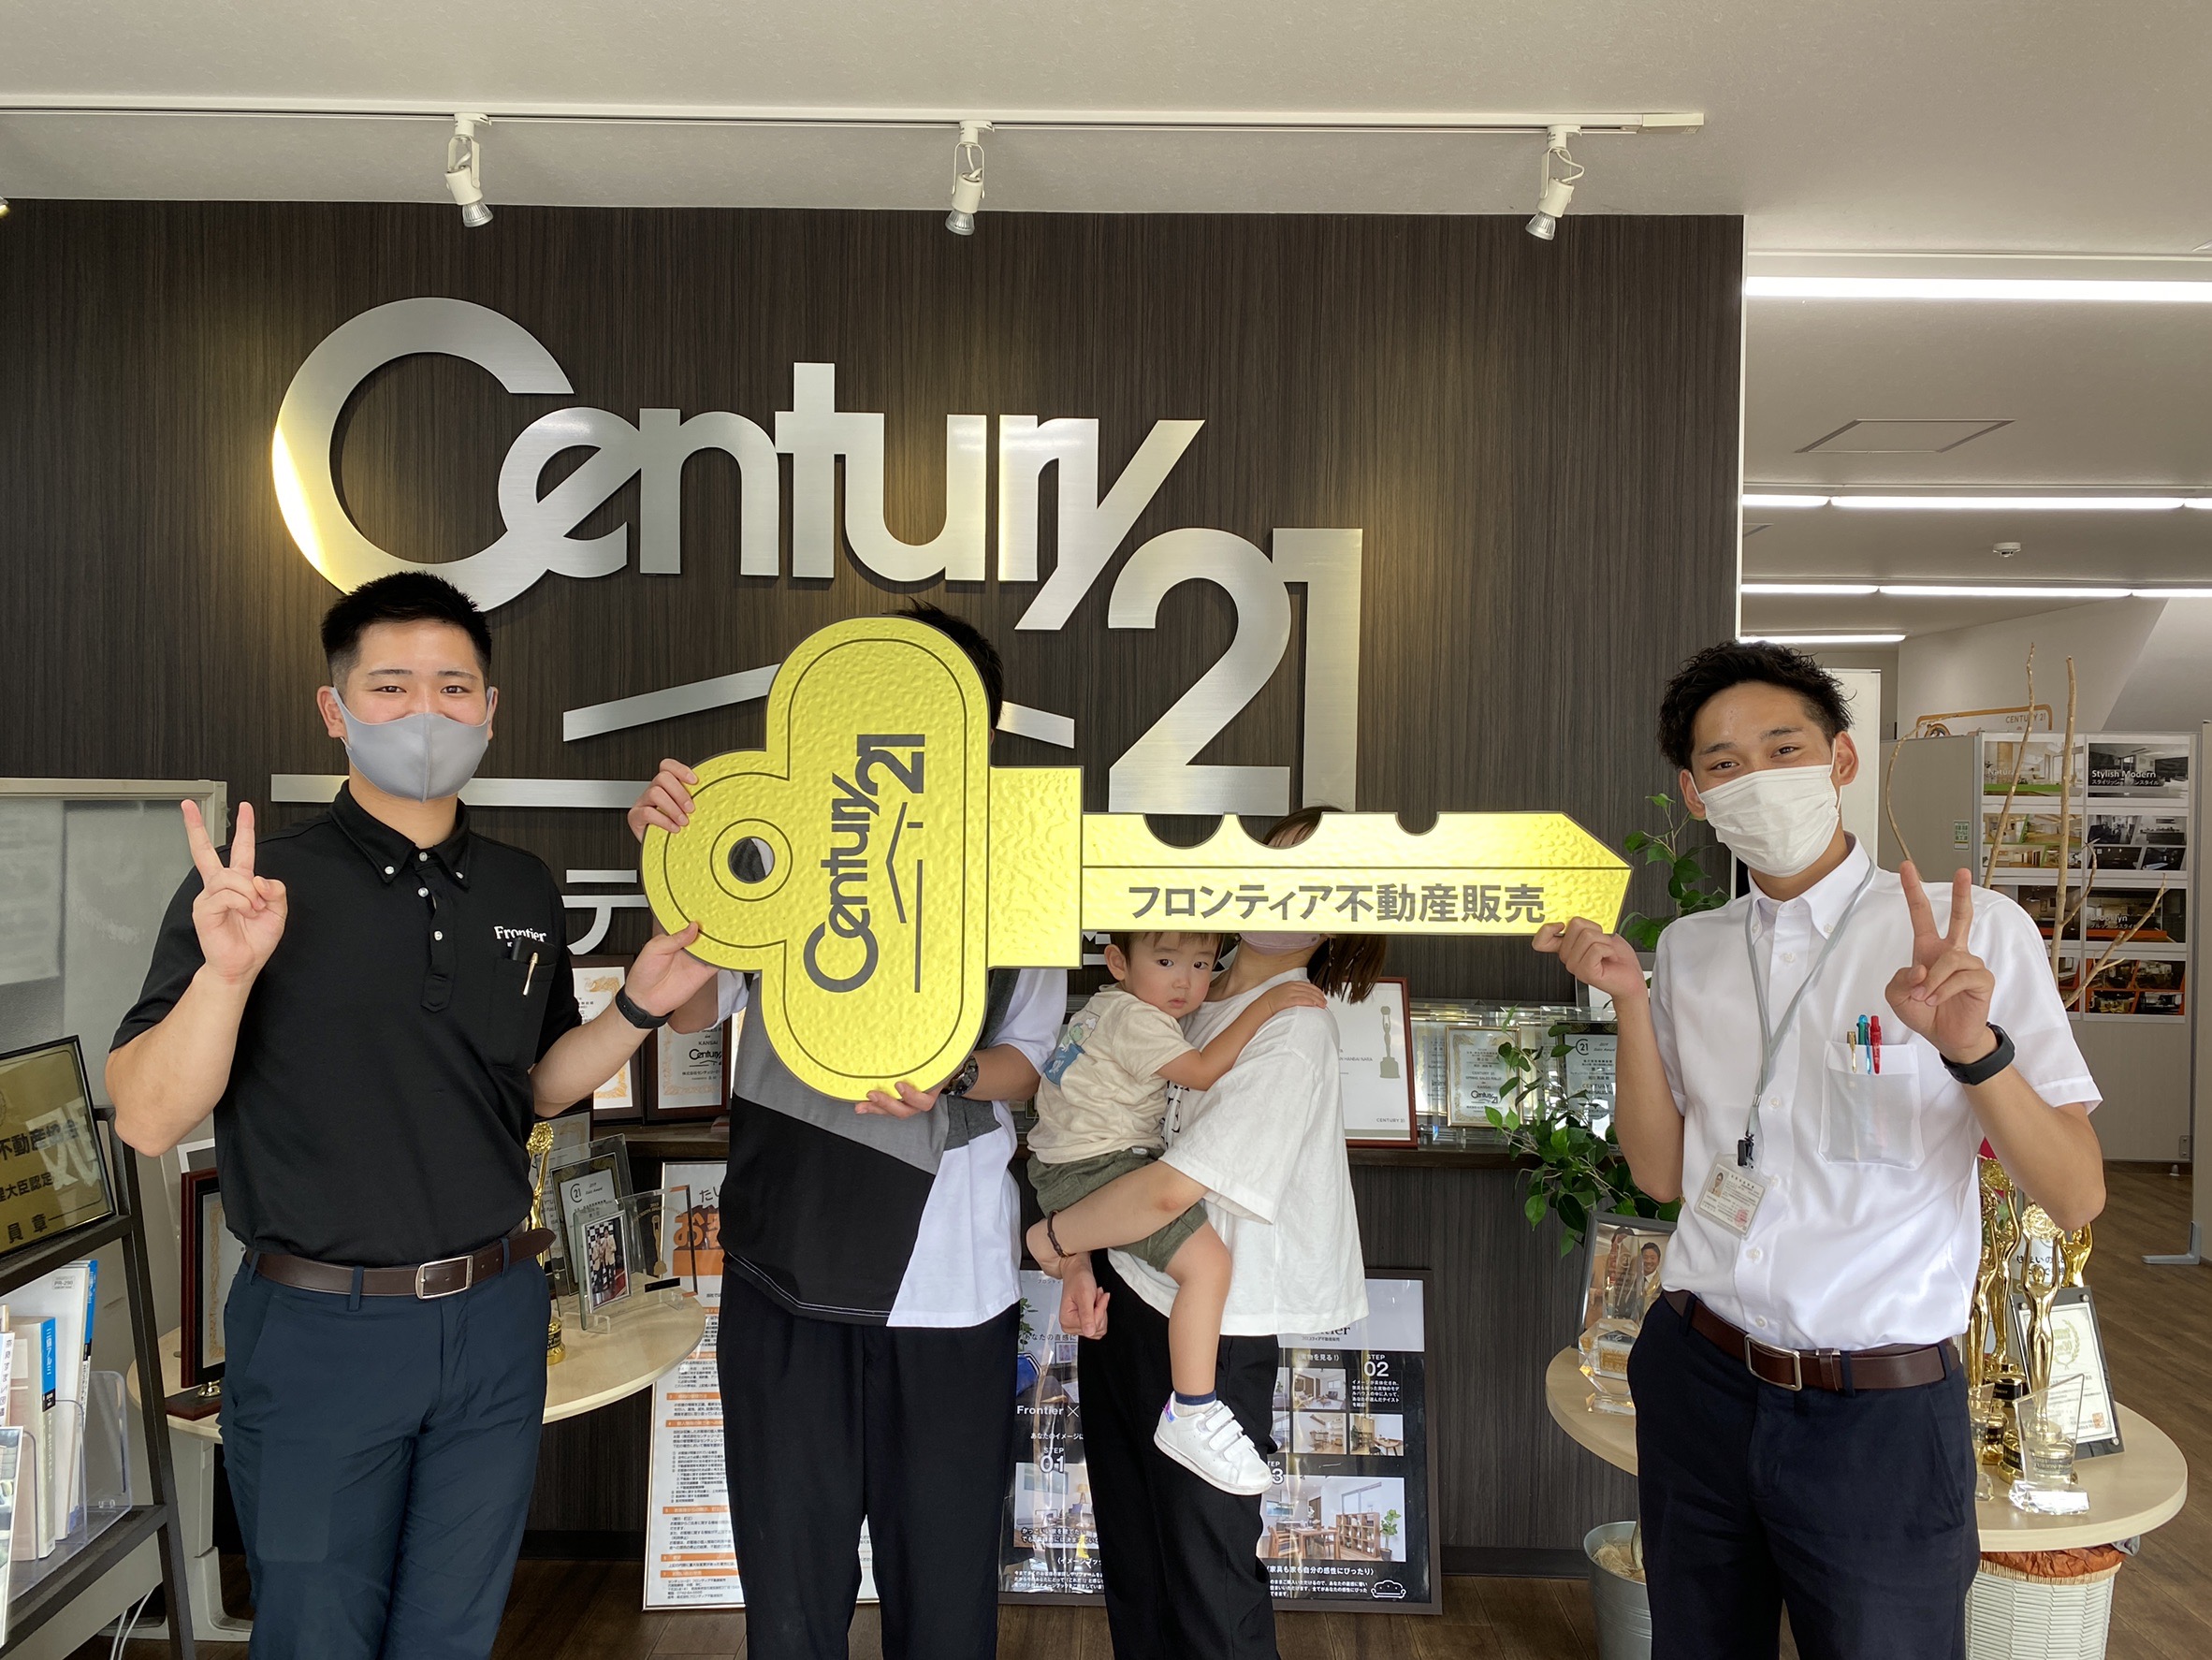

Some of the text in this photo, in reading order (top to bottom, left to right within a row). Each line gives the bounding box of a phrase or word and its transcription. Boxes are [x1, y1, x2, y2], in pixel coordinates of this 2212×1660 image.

[271, 297, 1204, 630] Century
[1108, 527, 1363, 815] 21
[2006, 714, 2038, 723] CENTUY
[2091, 770, 2156, 779] Stylish Modern
[804, 734, 925, 993] Century 21
[1128, 883, 1546, 923] フロンティア不動産販売
[494, 925, 546, 942] Frontier
[689, 1048, 721, 1060] Century
[1363, 1361, 1390, 1377] 02
[1017, 1405, 1064, 1416] Frontier
[1040, 1455, 1065, 1474] 01
[1272, 1467, 1284, 1484] 3
